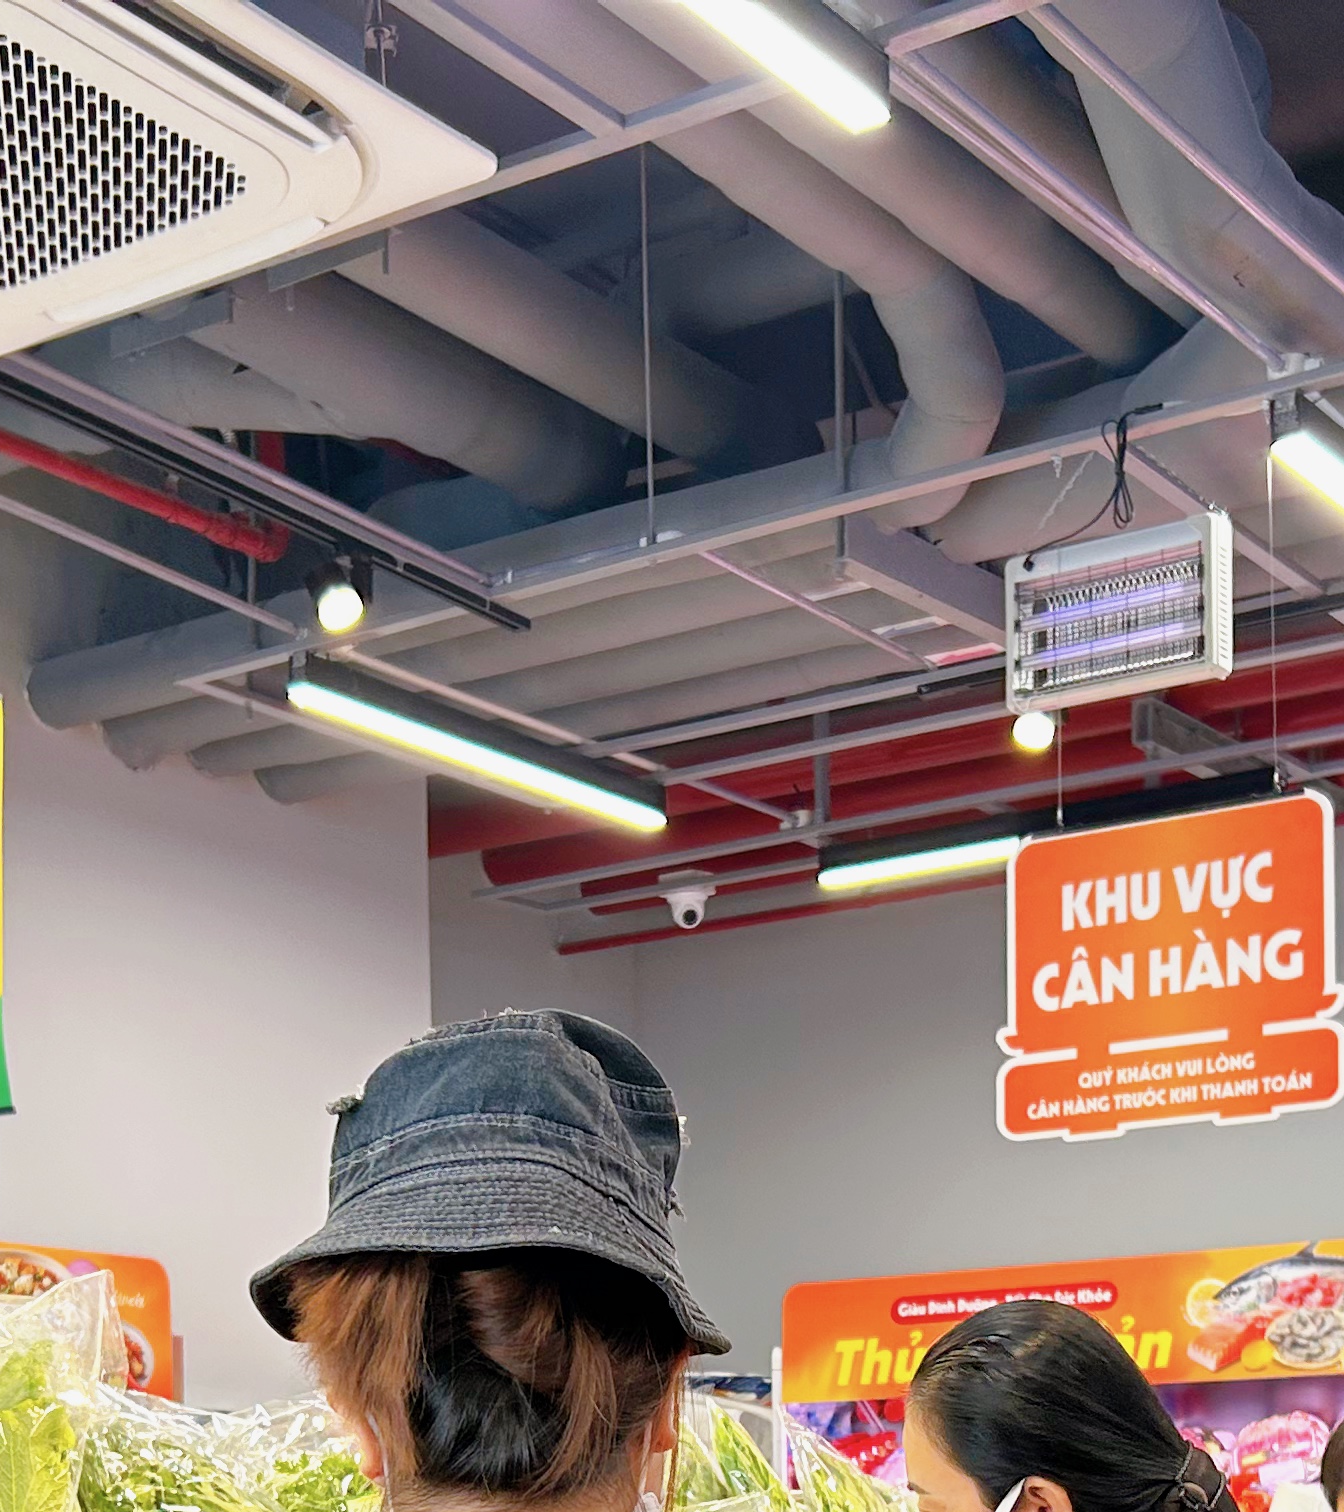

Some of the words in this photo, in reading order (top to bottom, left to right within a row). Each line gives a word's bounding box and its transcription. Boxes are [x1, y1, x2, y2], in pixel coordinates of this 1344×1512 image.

[1061, 869, 1160, 931] KHU
[1173, 851, 1274, 919] VỰC
[1032, 946, 1135, 1012] CÂN
[1149, 929, 1305, 998] HÀNG
[1027, 1098, 1060, 1121] CÂN
[1063, 1091, 1110, 1117] HÀNG
[1113, 1085, 1167, 1112] TRƯỚC
[1170, 1084, 1197, 1104] KHI
[1201, 1078, 1258, 1101] THANH
[1262, 1069, 1312, 1093] TOÁN
[1078, 1067, 1113, 1089] QUÝ
[1116, 1060, 1172, 1085] KHÁCH
[1175, 1058, 1203, 1077] VUI
[1206, 1052, 1255, 1075] LÒNG
[835, 1331, 927, 1386] Thủ
[1116, 1316, 1173, 1369] ản
